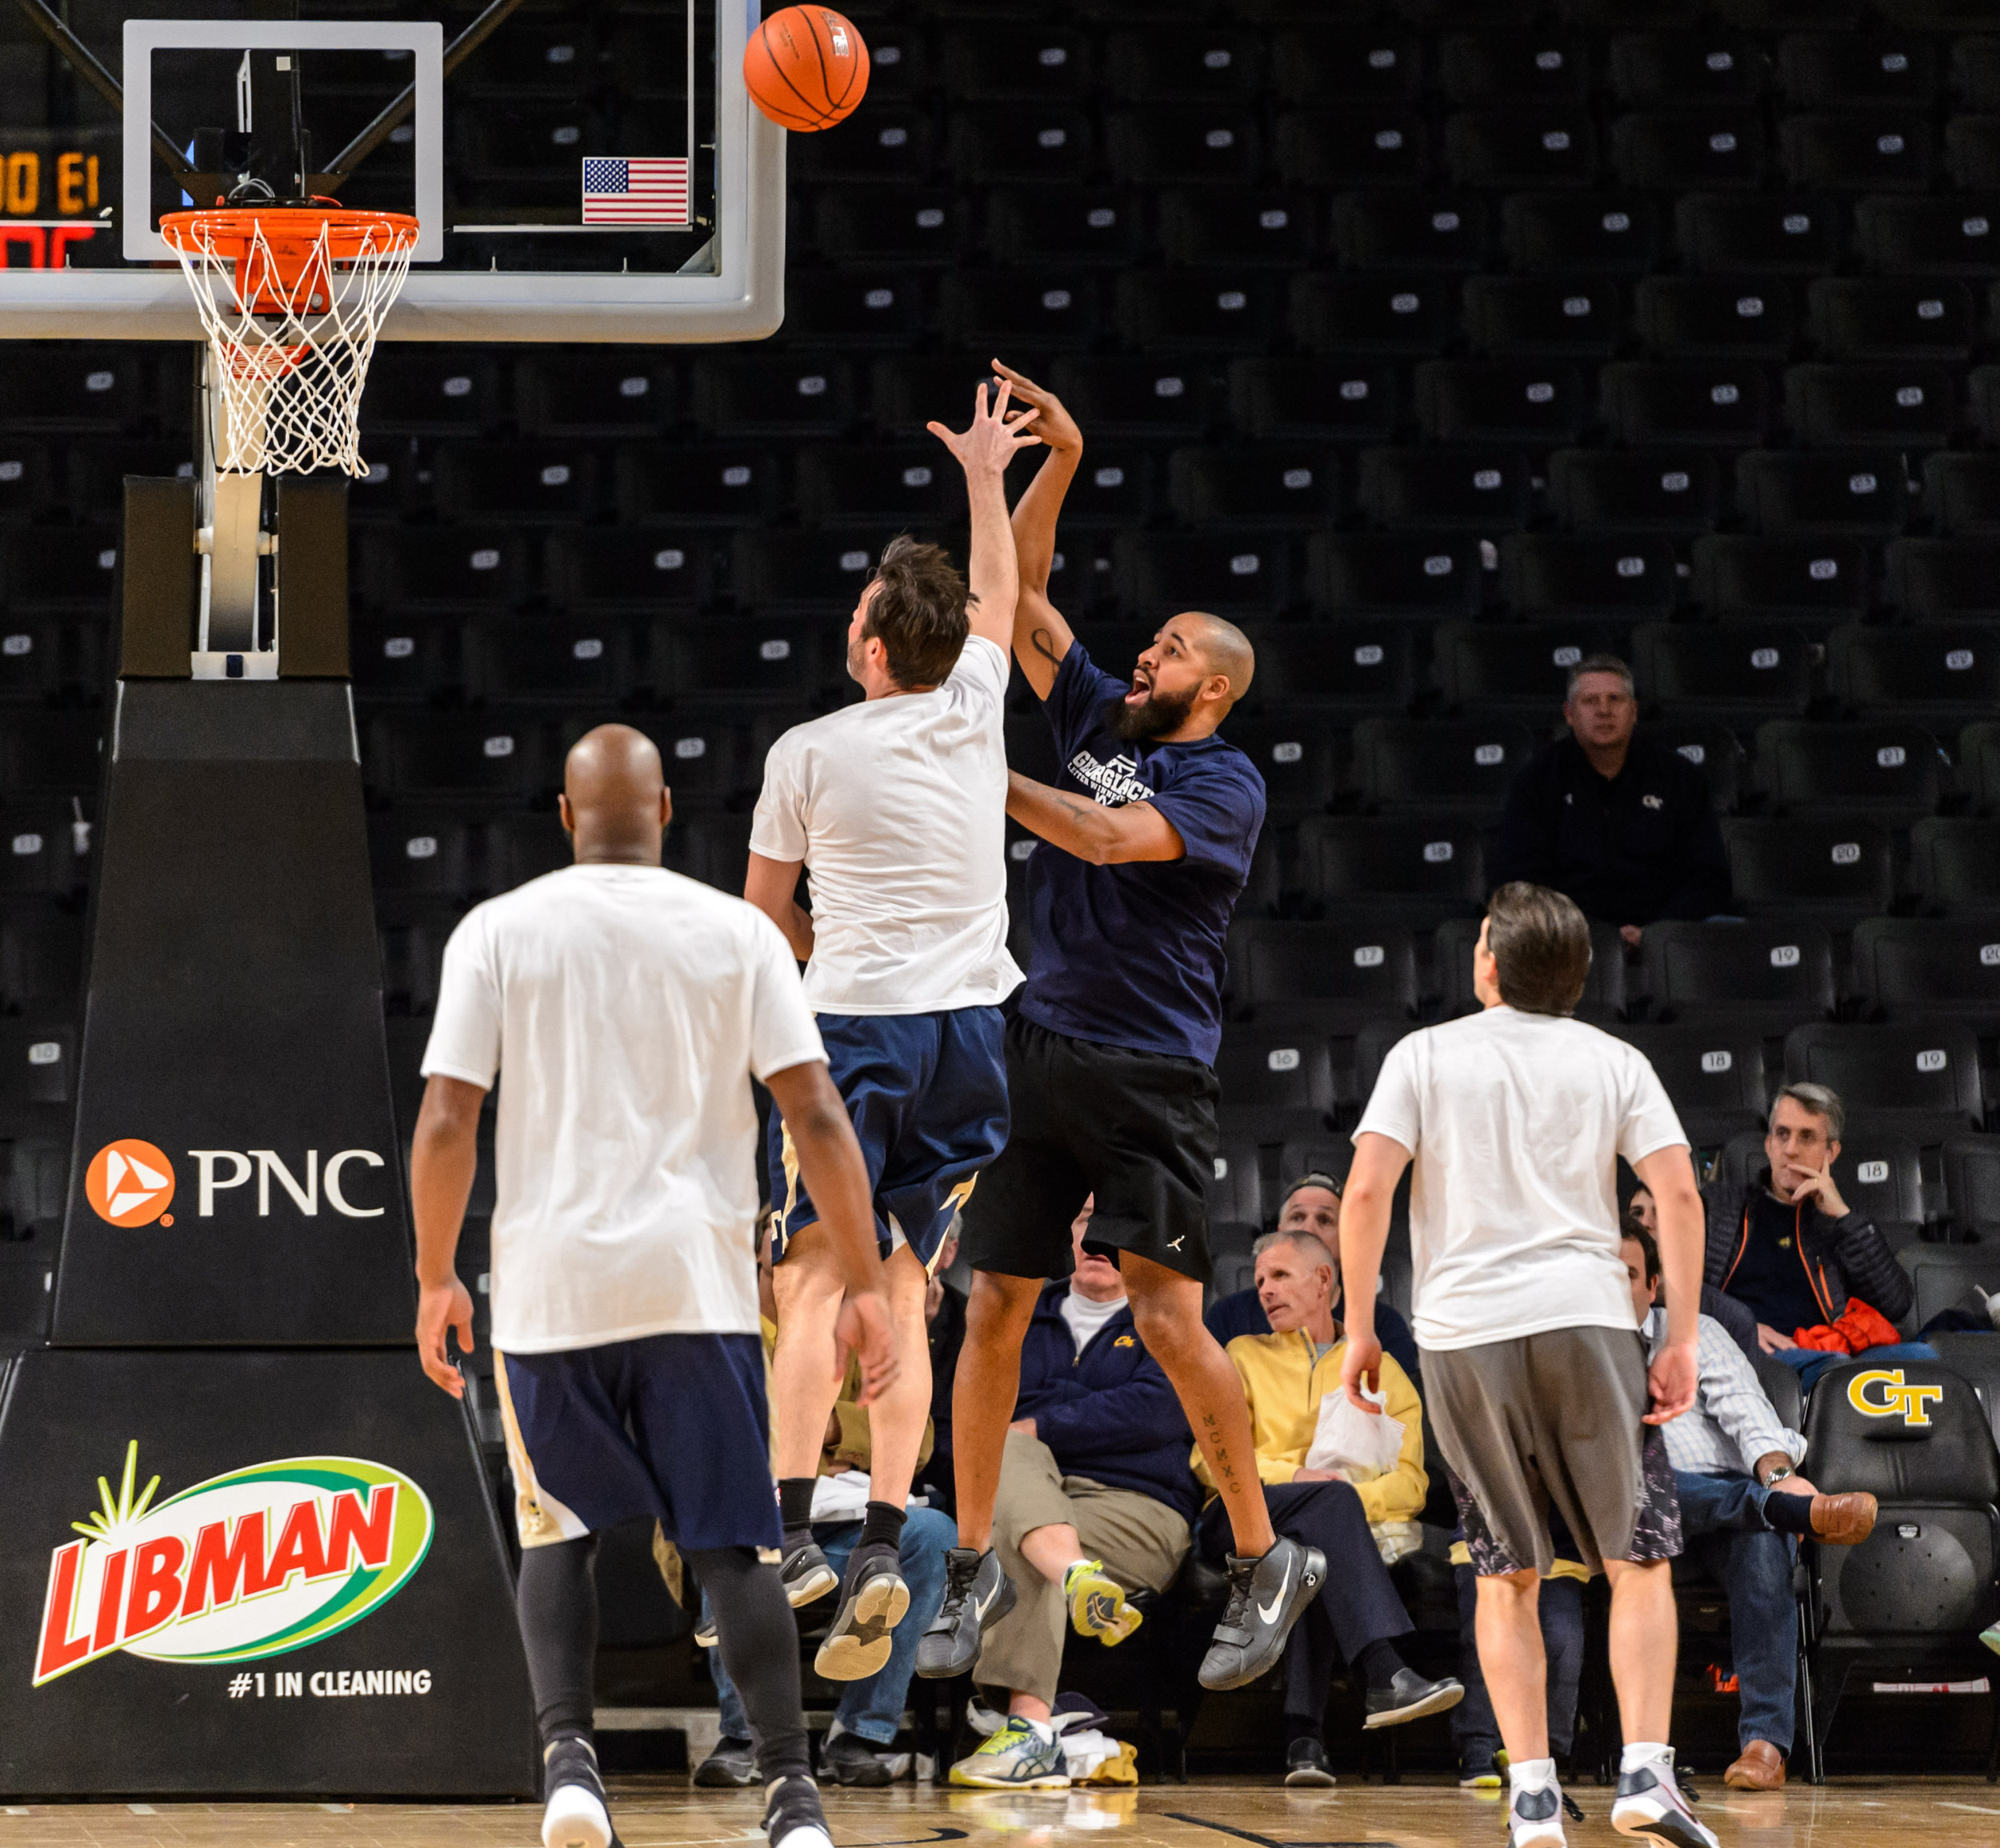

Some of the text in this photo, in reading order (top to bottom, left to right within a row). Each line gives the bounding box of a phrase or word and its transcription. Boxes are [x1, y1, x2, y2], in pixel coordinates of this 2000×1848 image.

[188, 1149, 385, 1218] PNC
[1847, 1369, 1943, 1427] GT
[34, 1484, 398, 1683] LIBMAN
[227, 1669, 432, 1699] #1 IN CLEANING
